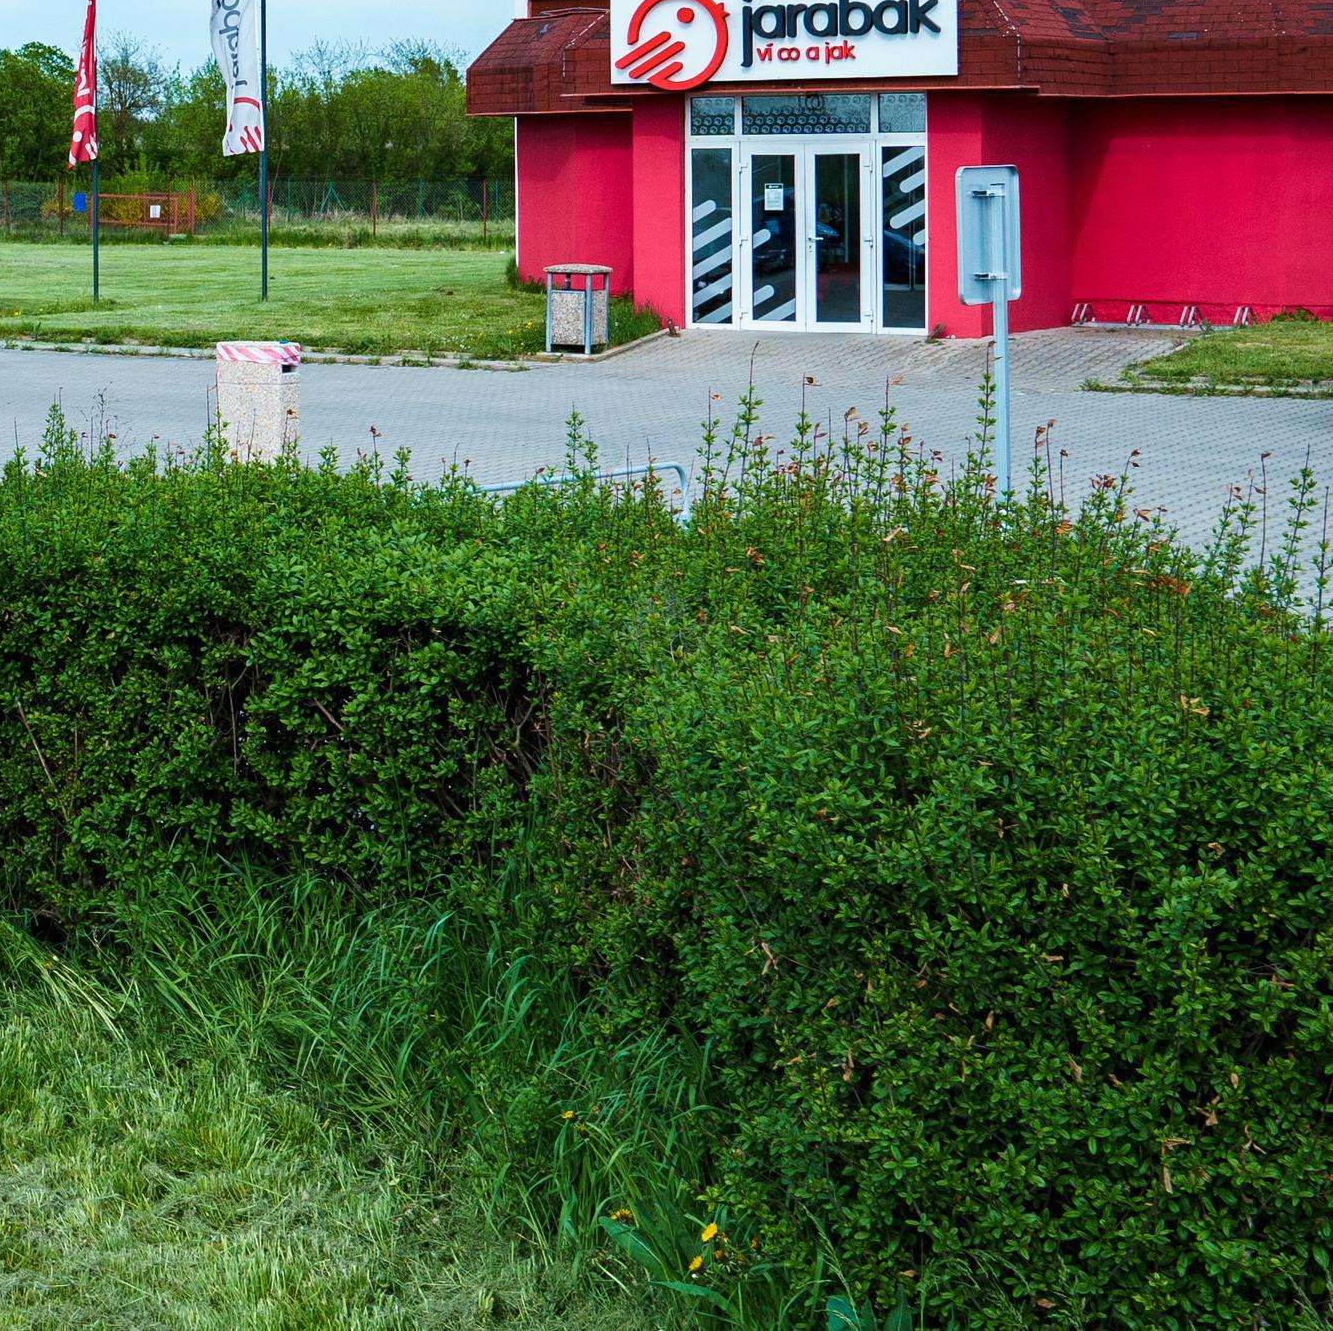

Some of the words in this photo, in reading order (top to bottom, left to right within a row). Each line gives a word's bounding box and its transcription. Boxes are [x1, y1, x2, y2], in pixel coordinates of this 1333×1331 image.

[756, 42, 774, 62] ví
[777, 47, 800, 61] co
[805, 46, 820, 60] a
[824, 40, 856, 64] jak
